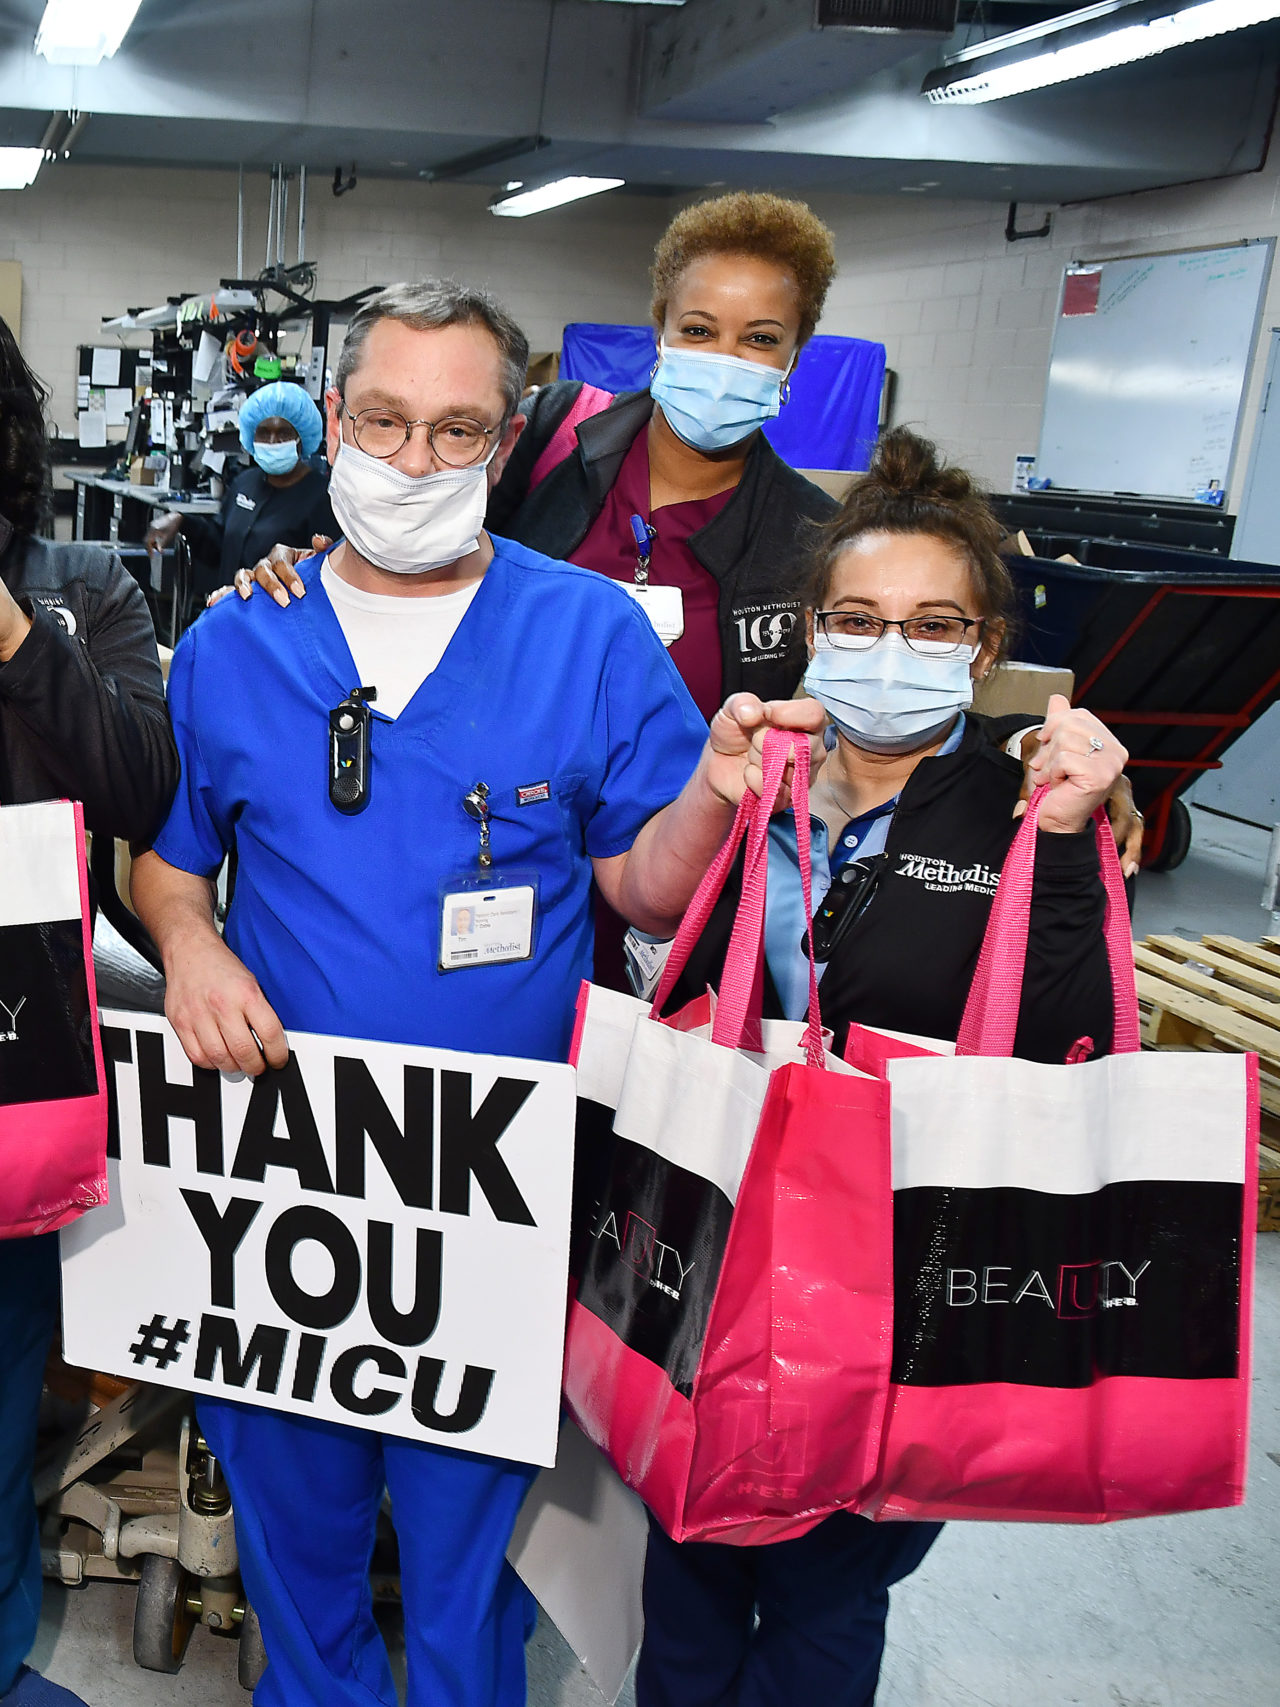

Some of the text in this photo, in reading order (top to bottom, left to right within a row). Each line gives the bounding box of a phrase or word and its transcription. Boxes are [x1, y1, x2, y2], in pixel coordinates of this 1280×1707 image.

[732, 601, 801, 616] HOUSTON METHODIST
[894, 861, 1002, 886] Methodis
[899, 853, 947, 867] HOUSTON
[924, 882, 997, 896] LEADING MEDIC
[590, 1201, 696, 1291] AUTY
[178, 1187, 444, 1348] YOU
[947, 1259, 1152, 1311] BEAUTY
[129, 1312, 497, 1434] #MICU
